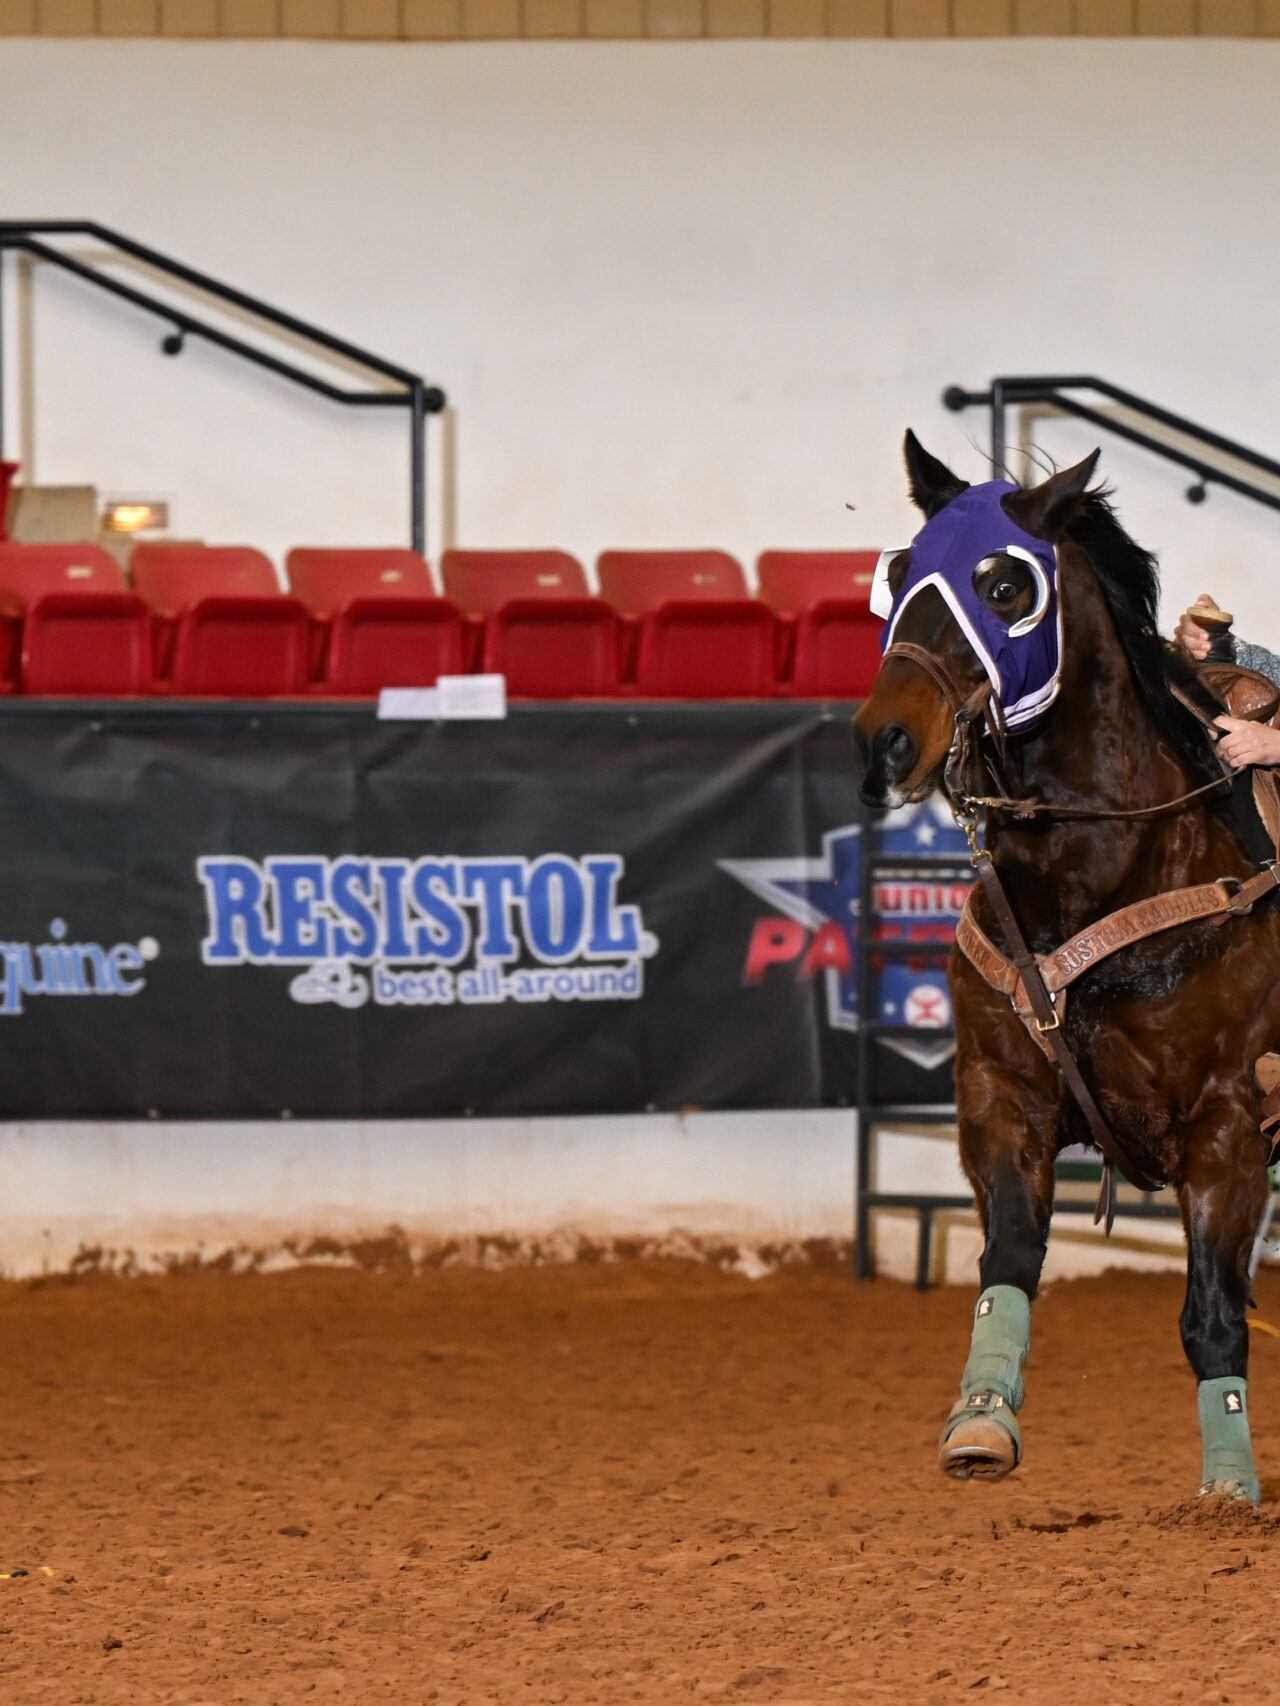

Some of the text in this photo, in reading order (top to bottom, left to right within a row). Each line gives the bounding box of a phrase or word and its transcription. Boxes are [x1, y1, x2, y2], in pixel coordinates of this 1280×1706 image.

[199, 856, 643, 962] RESISTOL
[376, 962, 642, 1002] best all-around
